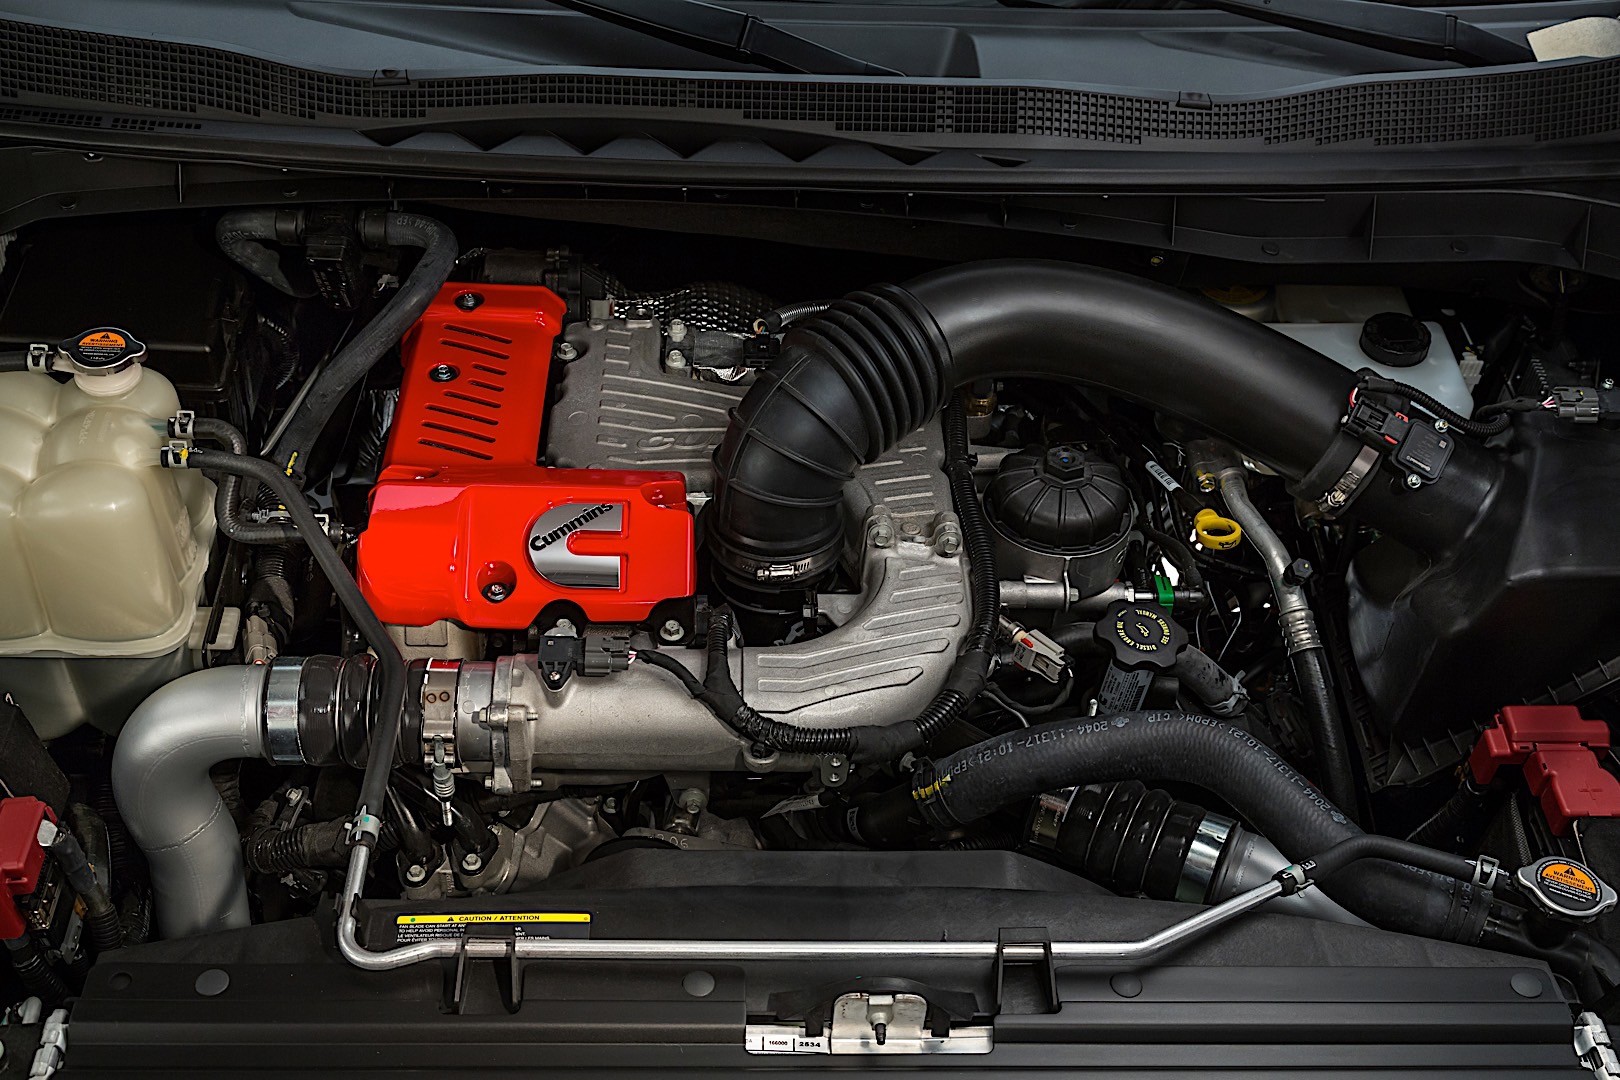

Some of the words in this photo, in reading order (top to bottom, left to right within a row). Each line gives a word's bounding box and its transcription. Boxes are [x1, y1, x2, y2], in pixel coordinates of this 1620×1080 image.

[529, 503, 613, 551] Cummins
[1147, 712, 1170, 723] CIP
[1545, 873, 1593, 892] AVERTISSEMENT
[1553, 870, 1586, 885] WARNING
